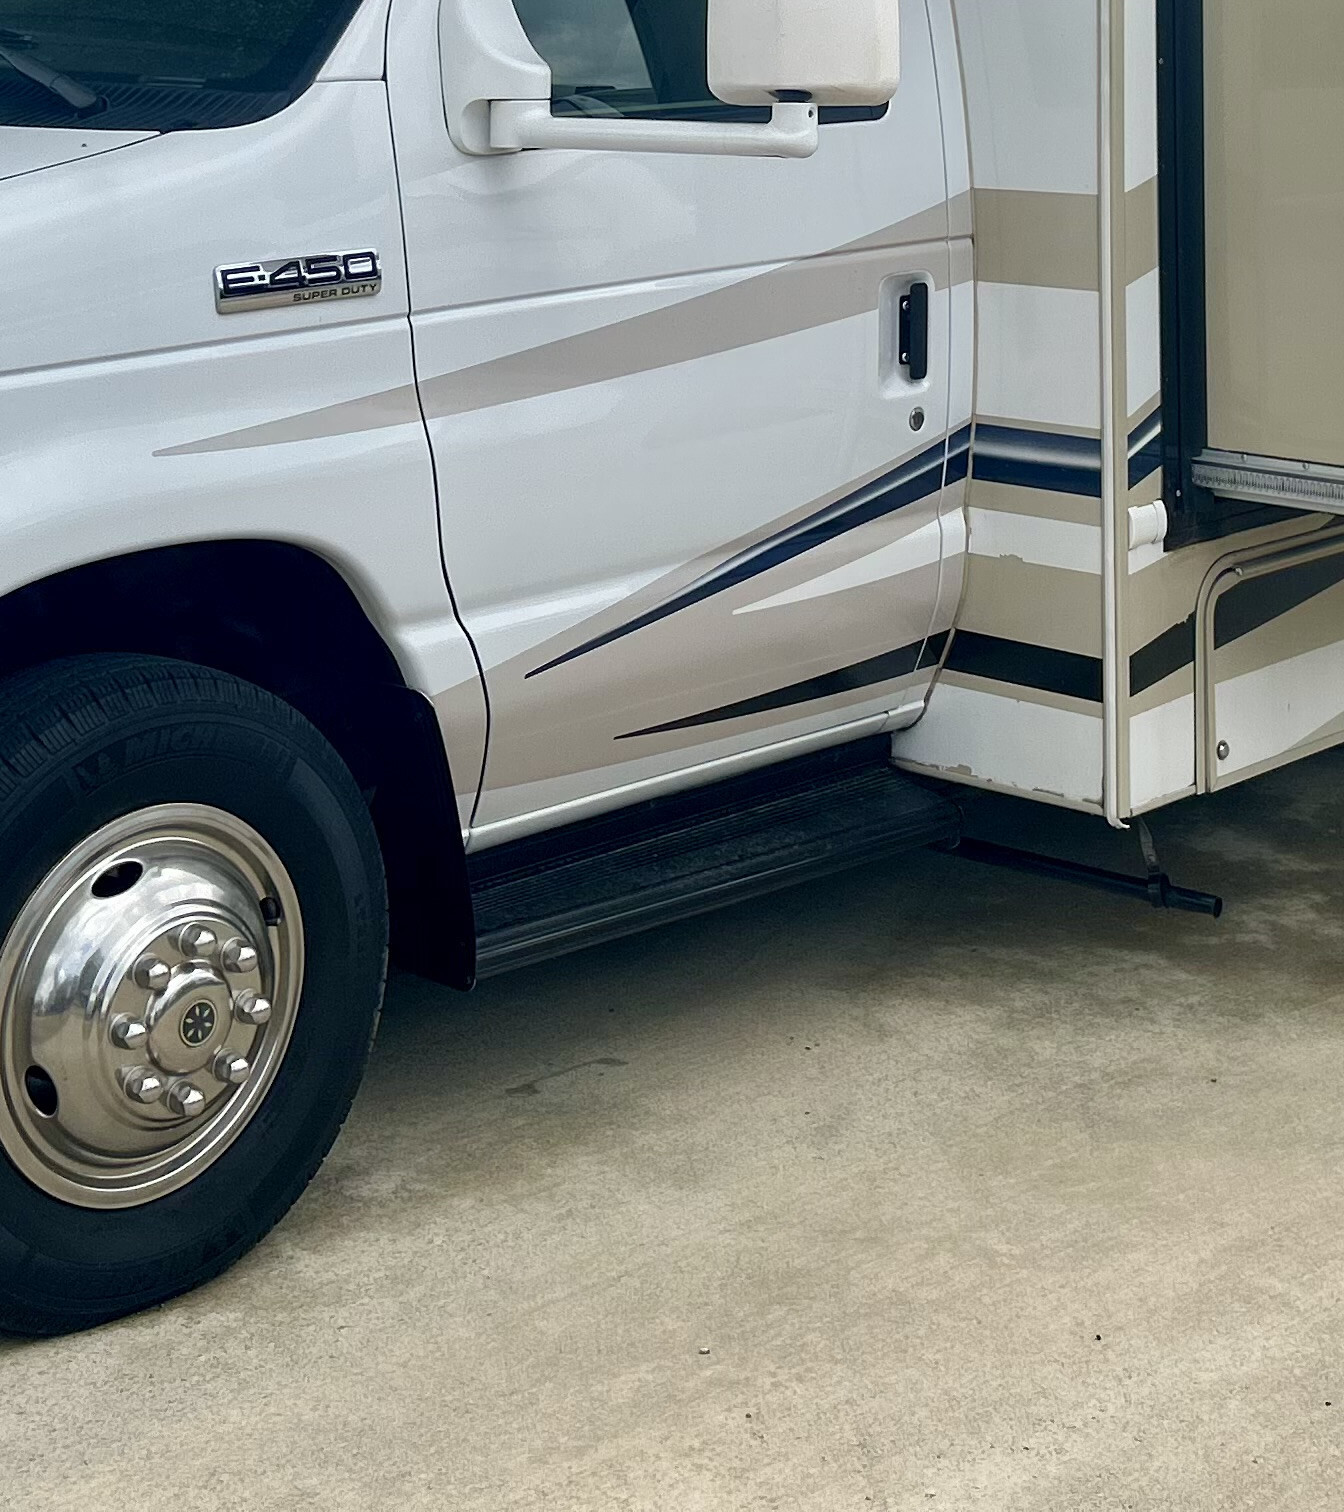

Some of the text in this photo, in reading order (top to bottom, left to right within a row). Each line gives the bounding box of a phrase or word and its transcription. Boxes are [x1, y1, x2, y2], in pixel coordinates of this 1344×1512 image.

[220, 251, 378, 296] E-450
[293, 284, 377, 303] SUPER DUTY
